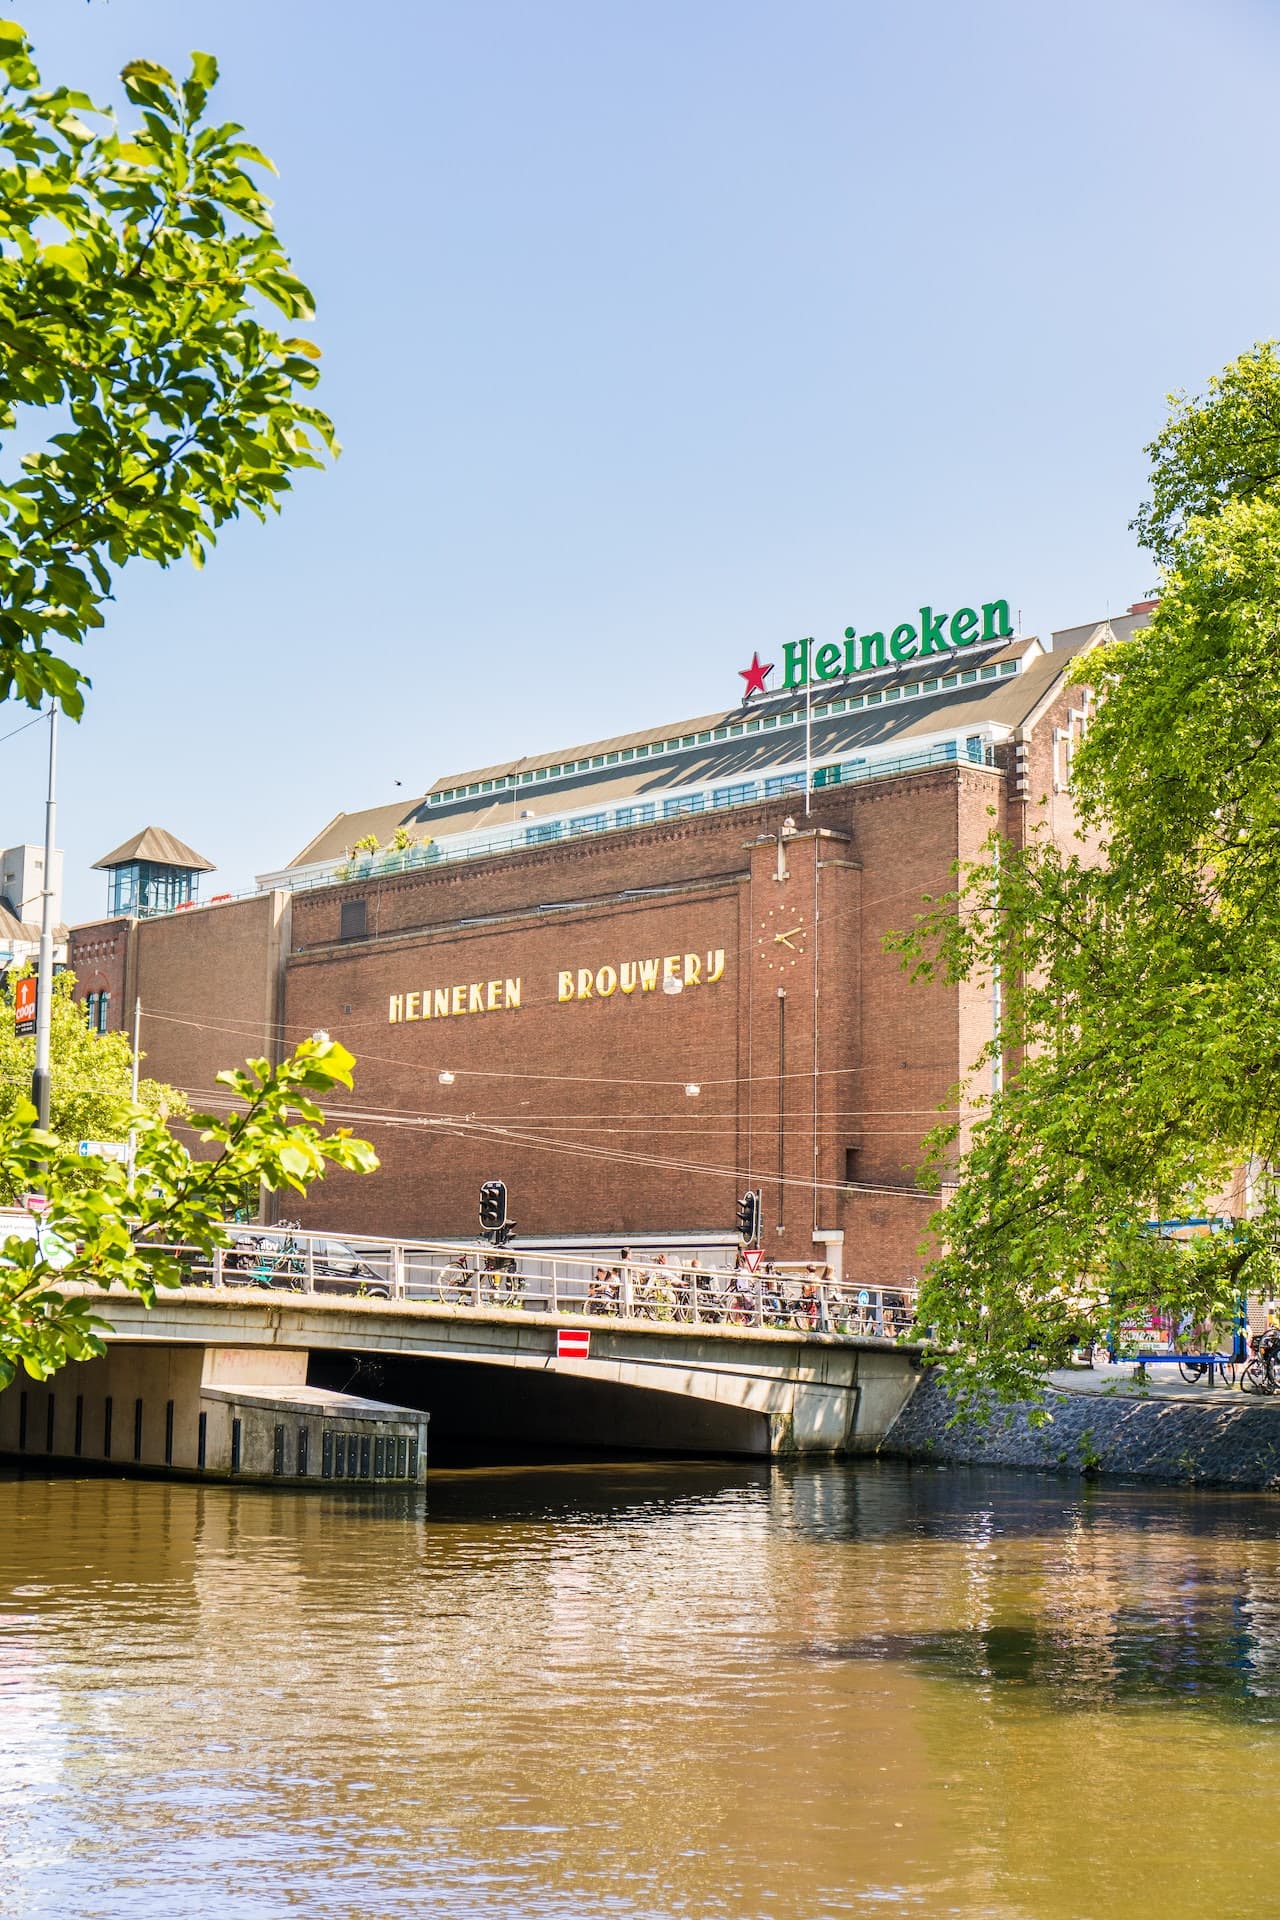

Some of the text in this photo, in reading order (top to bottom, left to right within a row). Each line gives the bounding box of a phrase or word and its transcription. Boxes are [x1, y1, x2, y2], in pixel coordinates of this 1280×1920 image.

[782, 599, 1013, 689] Heineken
[389, 948, 725, 1024] HEINEKEN BROUWERIJ
